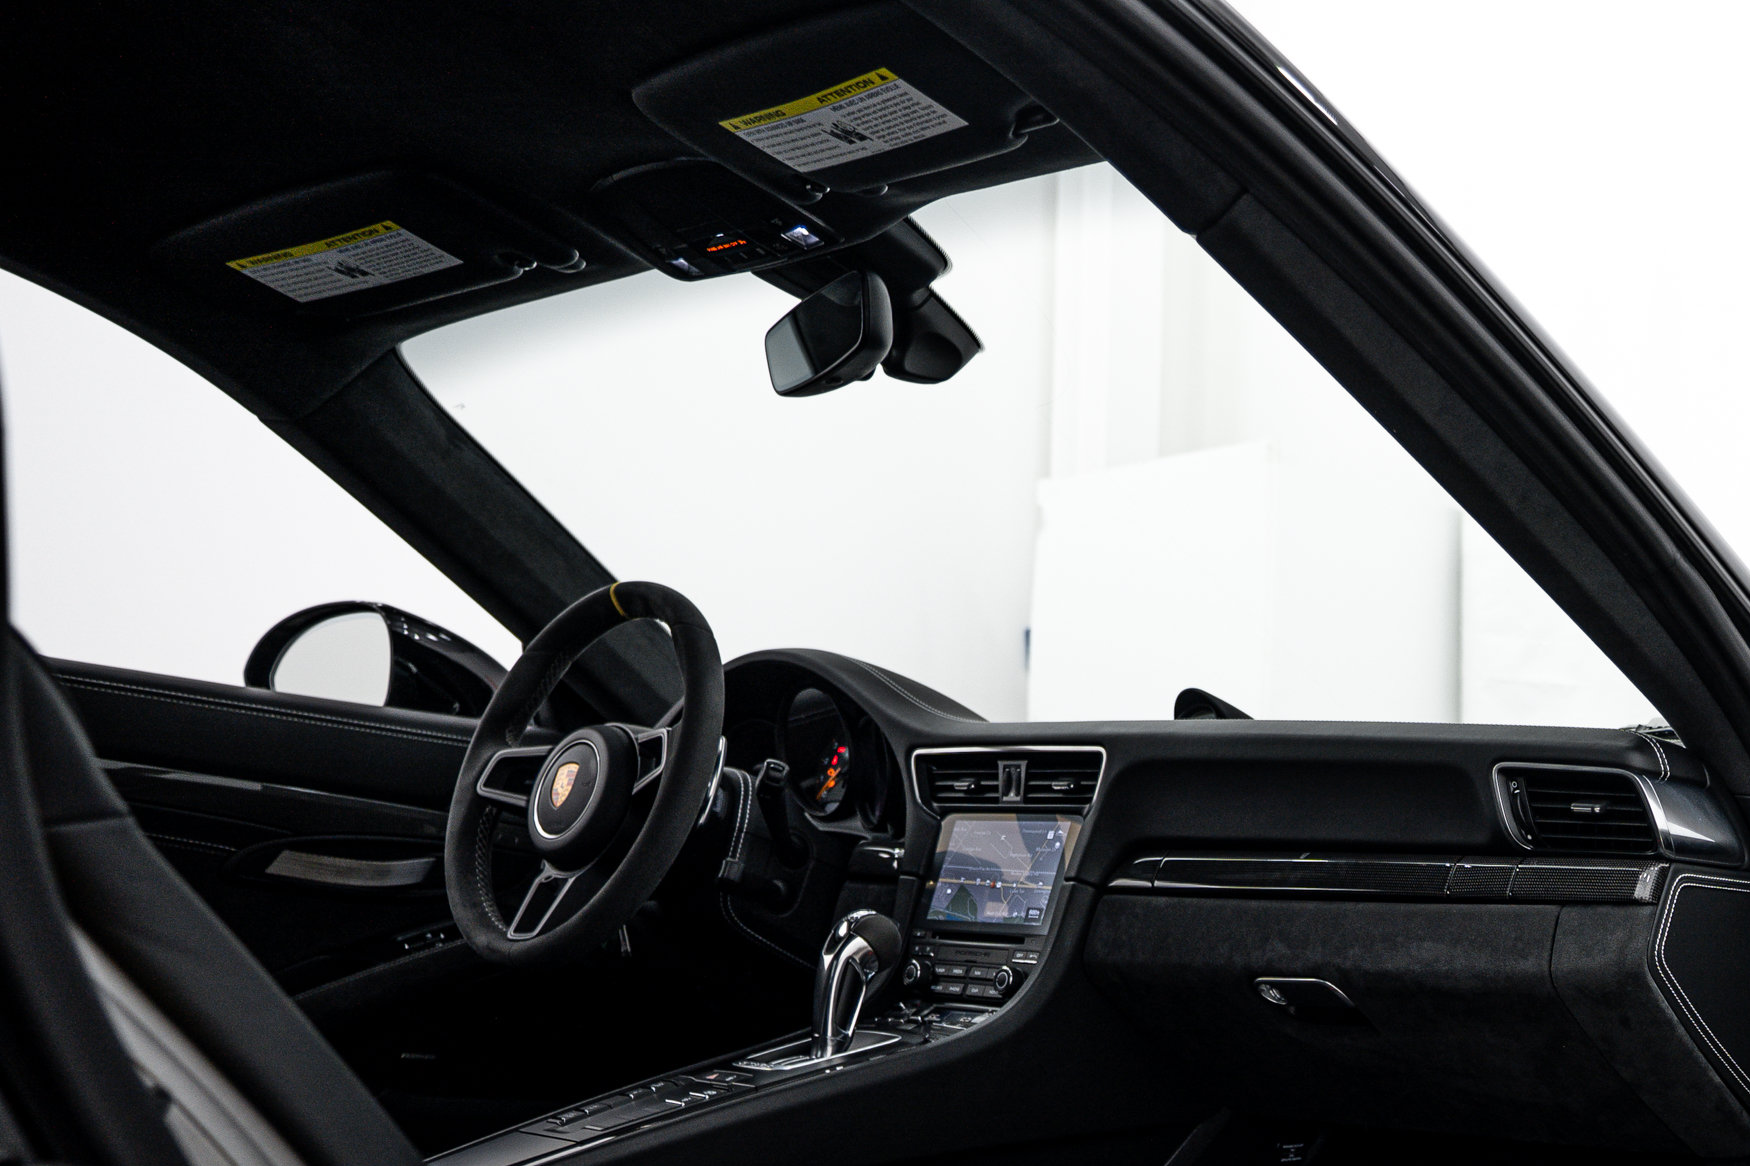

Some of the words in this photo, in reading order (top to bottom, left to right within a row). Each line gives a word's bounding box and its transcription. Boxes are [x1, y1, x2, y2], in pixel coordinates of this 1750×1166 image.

[816, 77, 876, 105] ATTENTION
[740, 109, 787, 127] WARNING
[324, 227, 380, 250] ATTENTION
